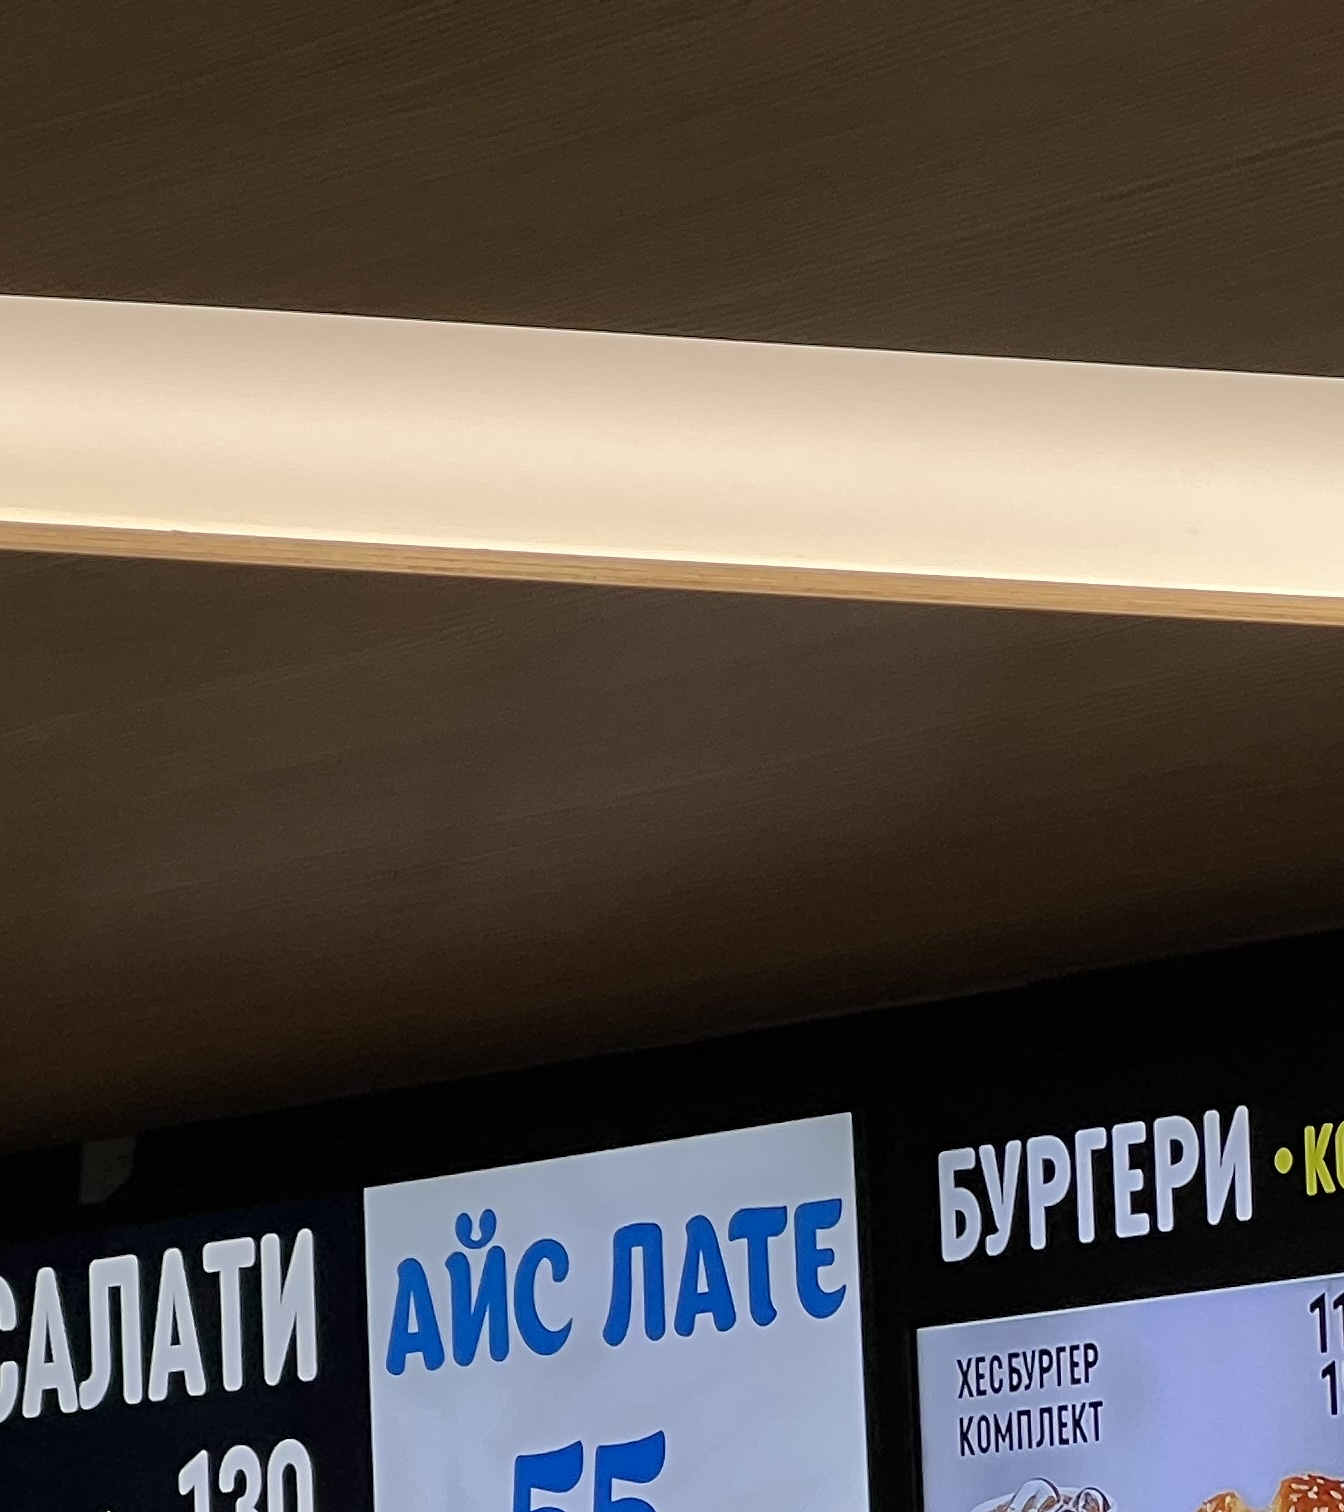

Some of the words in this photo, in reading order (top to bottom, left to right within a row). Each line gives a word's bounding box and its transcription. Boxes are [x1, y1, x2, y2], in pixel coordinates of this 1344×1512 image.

[937, 1104, 1253, 1263] БУРГЕРИ
[385, 1208, 574, 1376] АЙС
[602, 1197, 847, 1347] ЛАТЕ
[956, 1342, 1099, 1399] ХЕСБУРГЕР
[959, 1400, 1104, 1457] КОМПЛЕКТ
